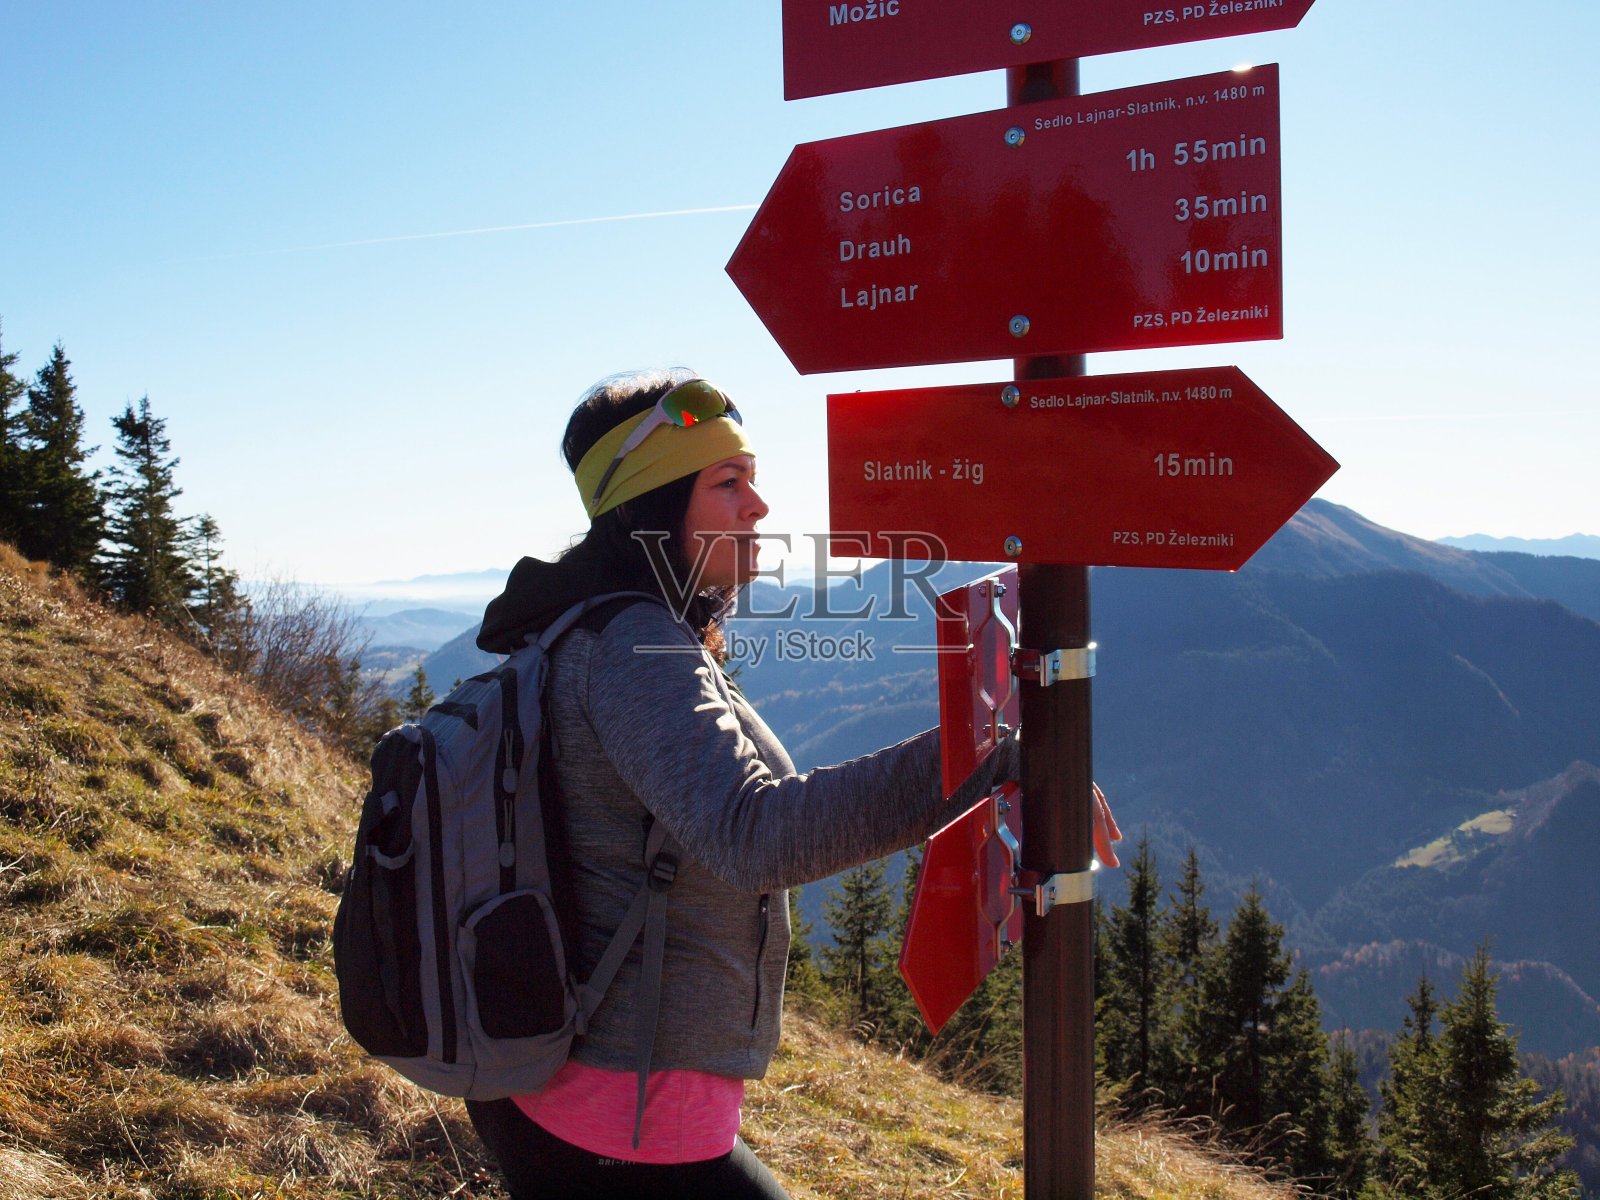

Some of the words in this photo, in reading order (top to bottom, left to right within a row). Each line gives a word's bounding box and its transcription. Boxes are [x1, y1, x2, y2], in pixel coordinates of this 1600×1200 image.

[829, 0, 900, 26] Možic
[1143, 9, 1180, 26] PZS,
[1182, 5, 1205, 20] PD
[1035, 115, 1073, 131] Sedlo
[1077, 98, 1181, 124] Lajnar-Slatnik,
[1186, 94, 1209, 107] n.v.
[1213, 85, 1248, 103] 1480
[1252, 84, 1266, 97] m
[1126, 147, 1156, 172] 1h
[1173, 133, 1267, 166] 55min
[839, 185, 921, 213] Sorica
[1174, 190, 1268, 222] 35min
[839, 233, 912, 262] Drauh
[1180, 245, 1269, 275] 10min
[840, 283, 919, 311] Lajnar
[1133, 313, 1168, 328] PZS,
[1171, 311, 1193, 325] PD
[1196, 304, 1270, 323] Železniki
[1030, 395, 1065, 409] Sedlo
[1066, 390, 1160, 408] Lajnar-Slatnik,
[1161, 389, 1182, 402] n.v.
[1184, 385, 1217, 401] 1480
[1219, 387, 1233, 399] m
[863, 459, 933, 481] Slatnik
[952, 458, 984, 485] žig
[1153, 451, 1234, 477] 15min
[1112, 531, 1144, 546] PZS,
[1146, 532, 1166, 545] PD
[1168, 529, 1235, 547] Železniki
